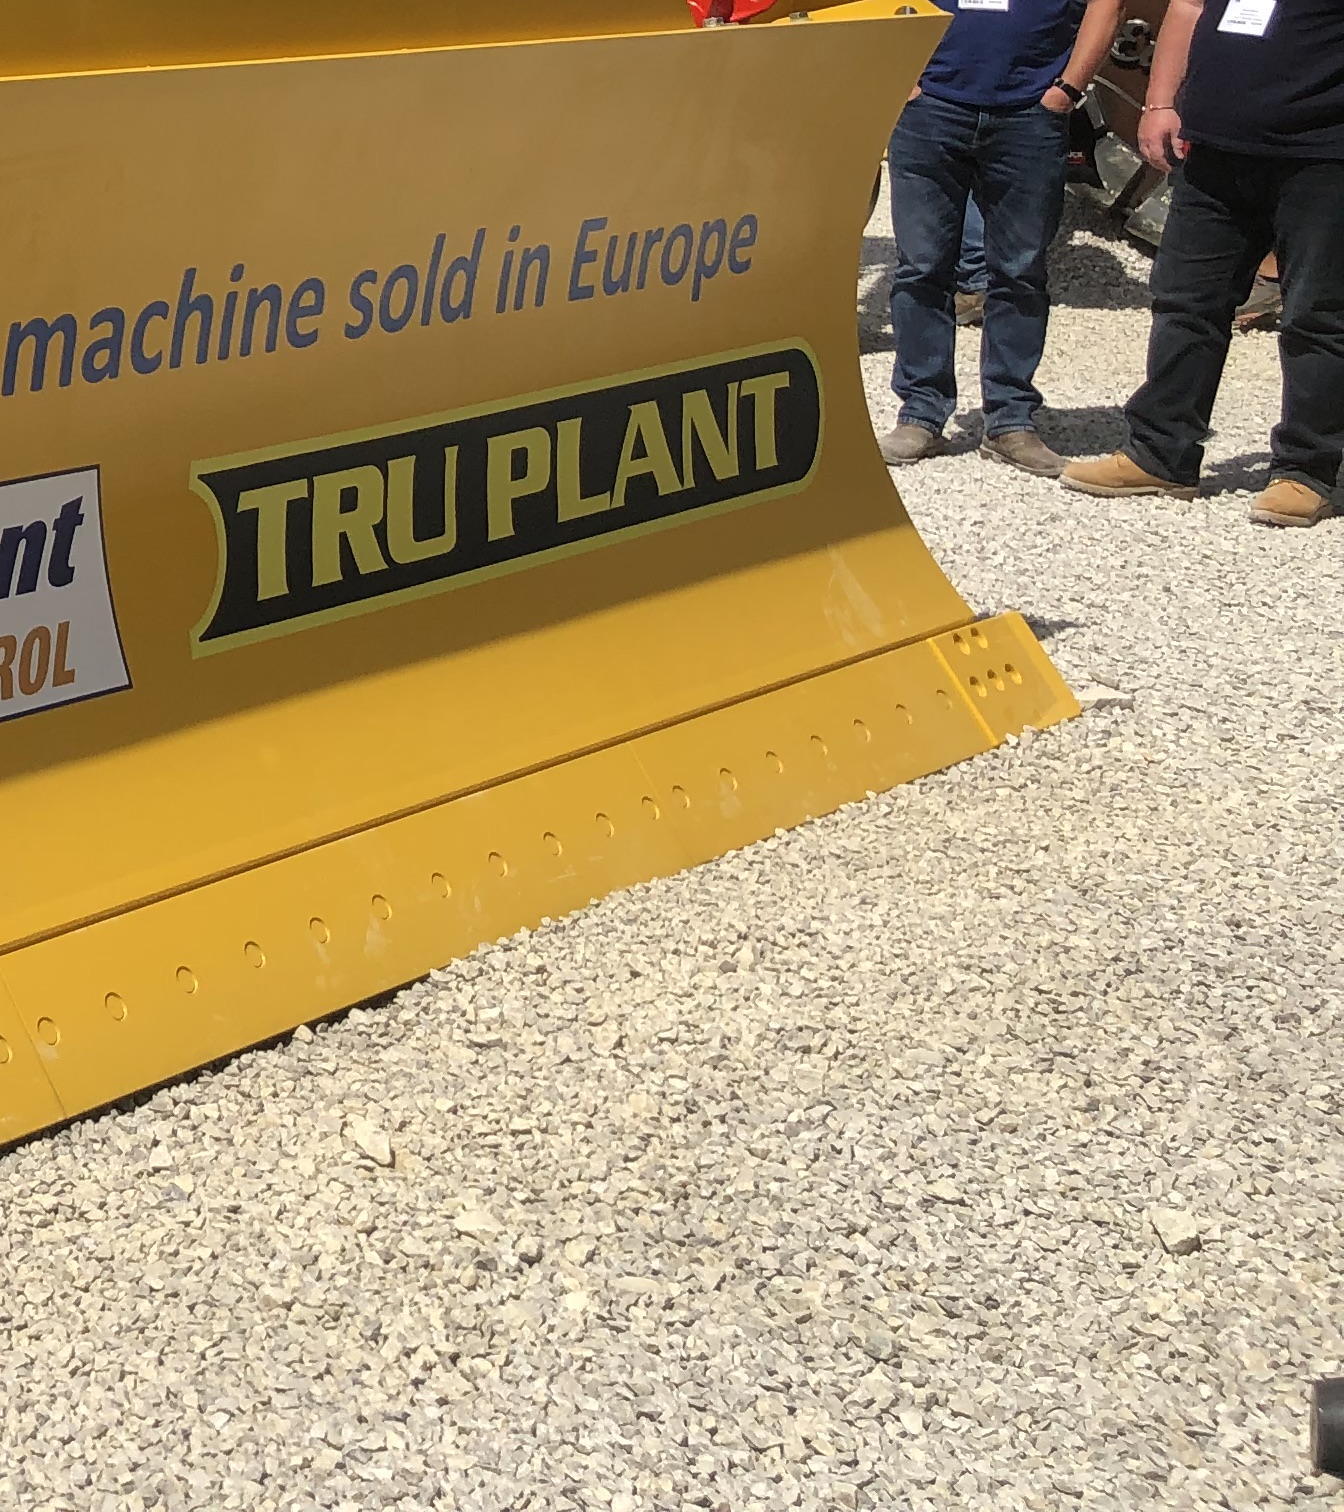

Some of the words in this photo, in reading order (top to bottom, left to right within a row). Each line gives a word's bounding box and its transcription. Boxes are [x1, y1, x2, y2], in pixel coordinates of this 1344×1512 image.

[1, 263, 325, 396] machine
[344, 227, 487, 340] sold
[495, 224, 550, 314] in
[569, 213, 758, 302] Europe
[237, 445, 458, 602] TRU
[487, 370, 791, 543] PLANT
